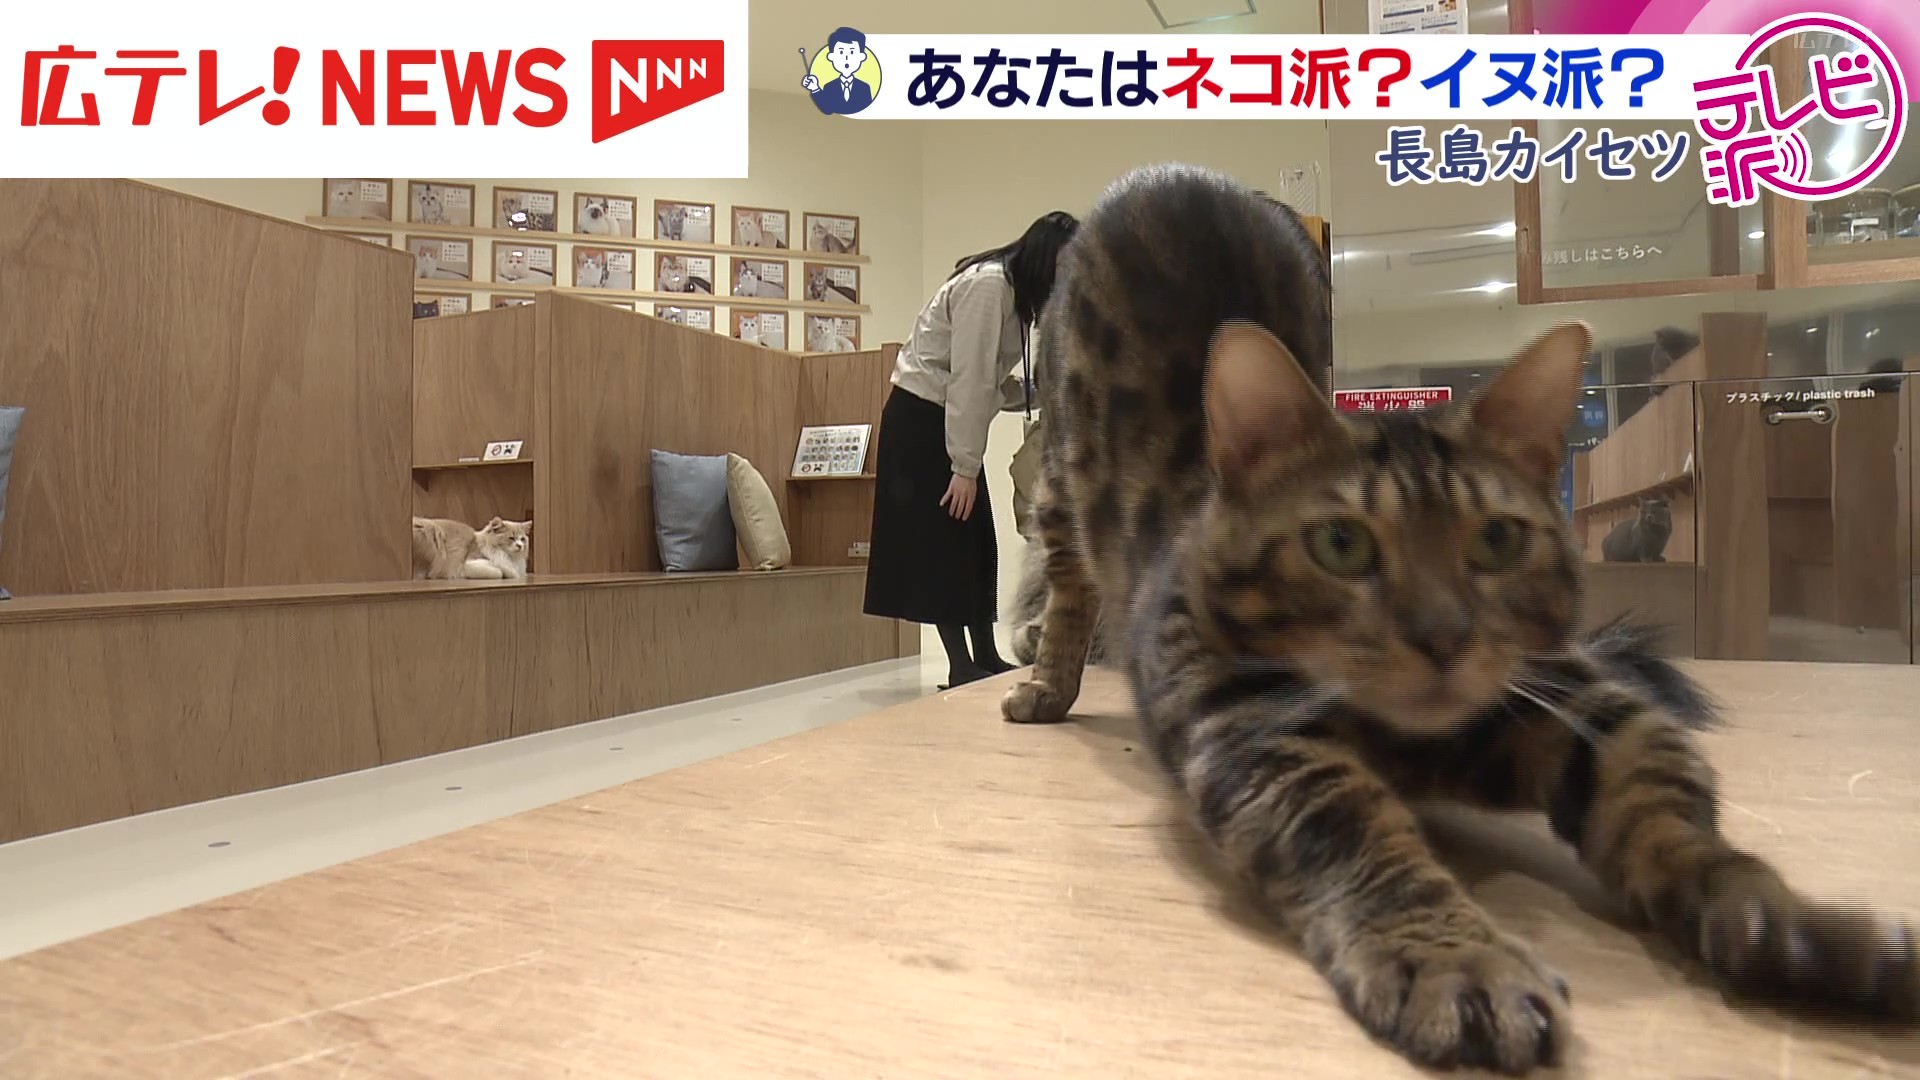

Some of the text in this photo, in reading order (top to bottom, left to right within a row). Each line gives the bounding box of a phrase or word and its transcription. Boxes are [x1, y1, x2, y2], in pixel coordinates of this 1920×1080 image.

[1370, 391, 1439, 401] EXTINGUISHER
[1802, 388, 1842, 402] plastic
[1844, 387, 1876, 399] trash
